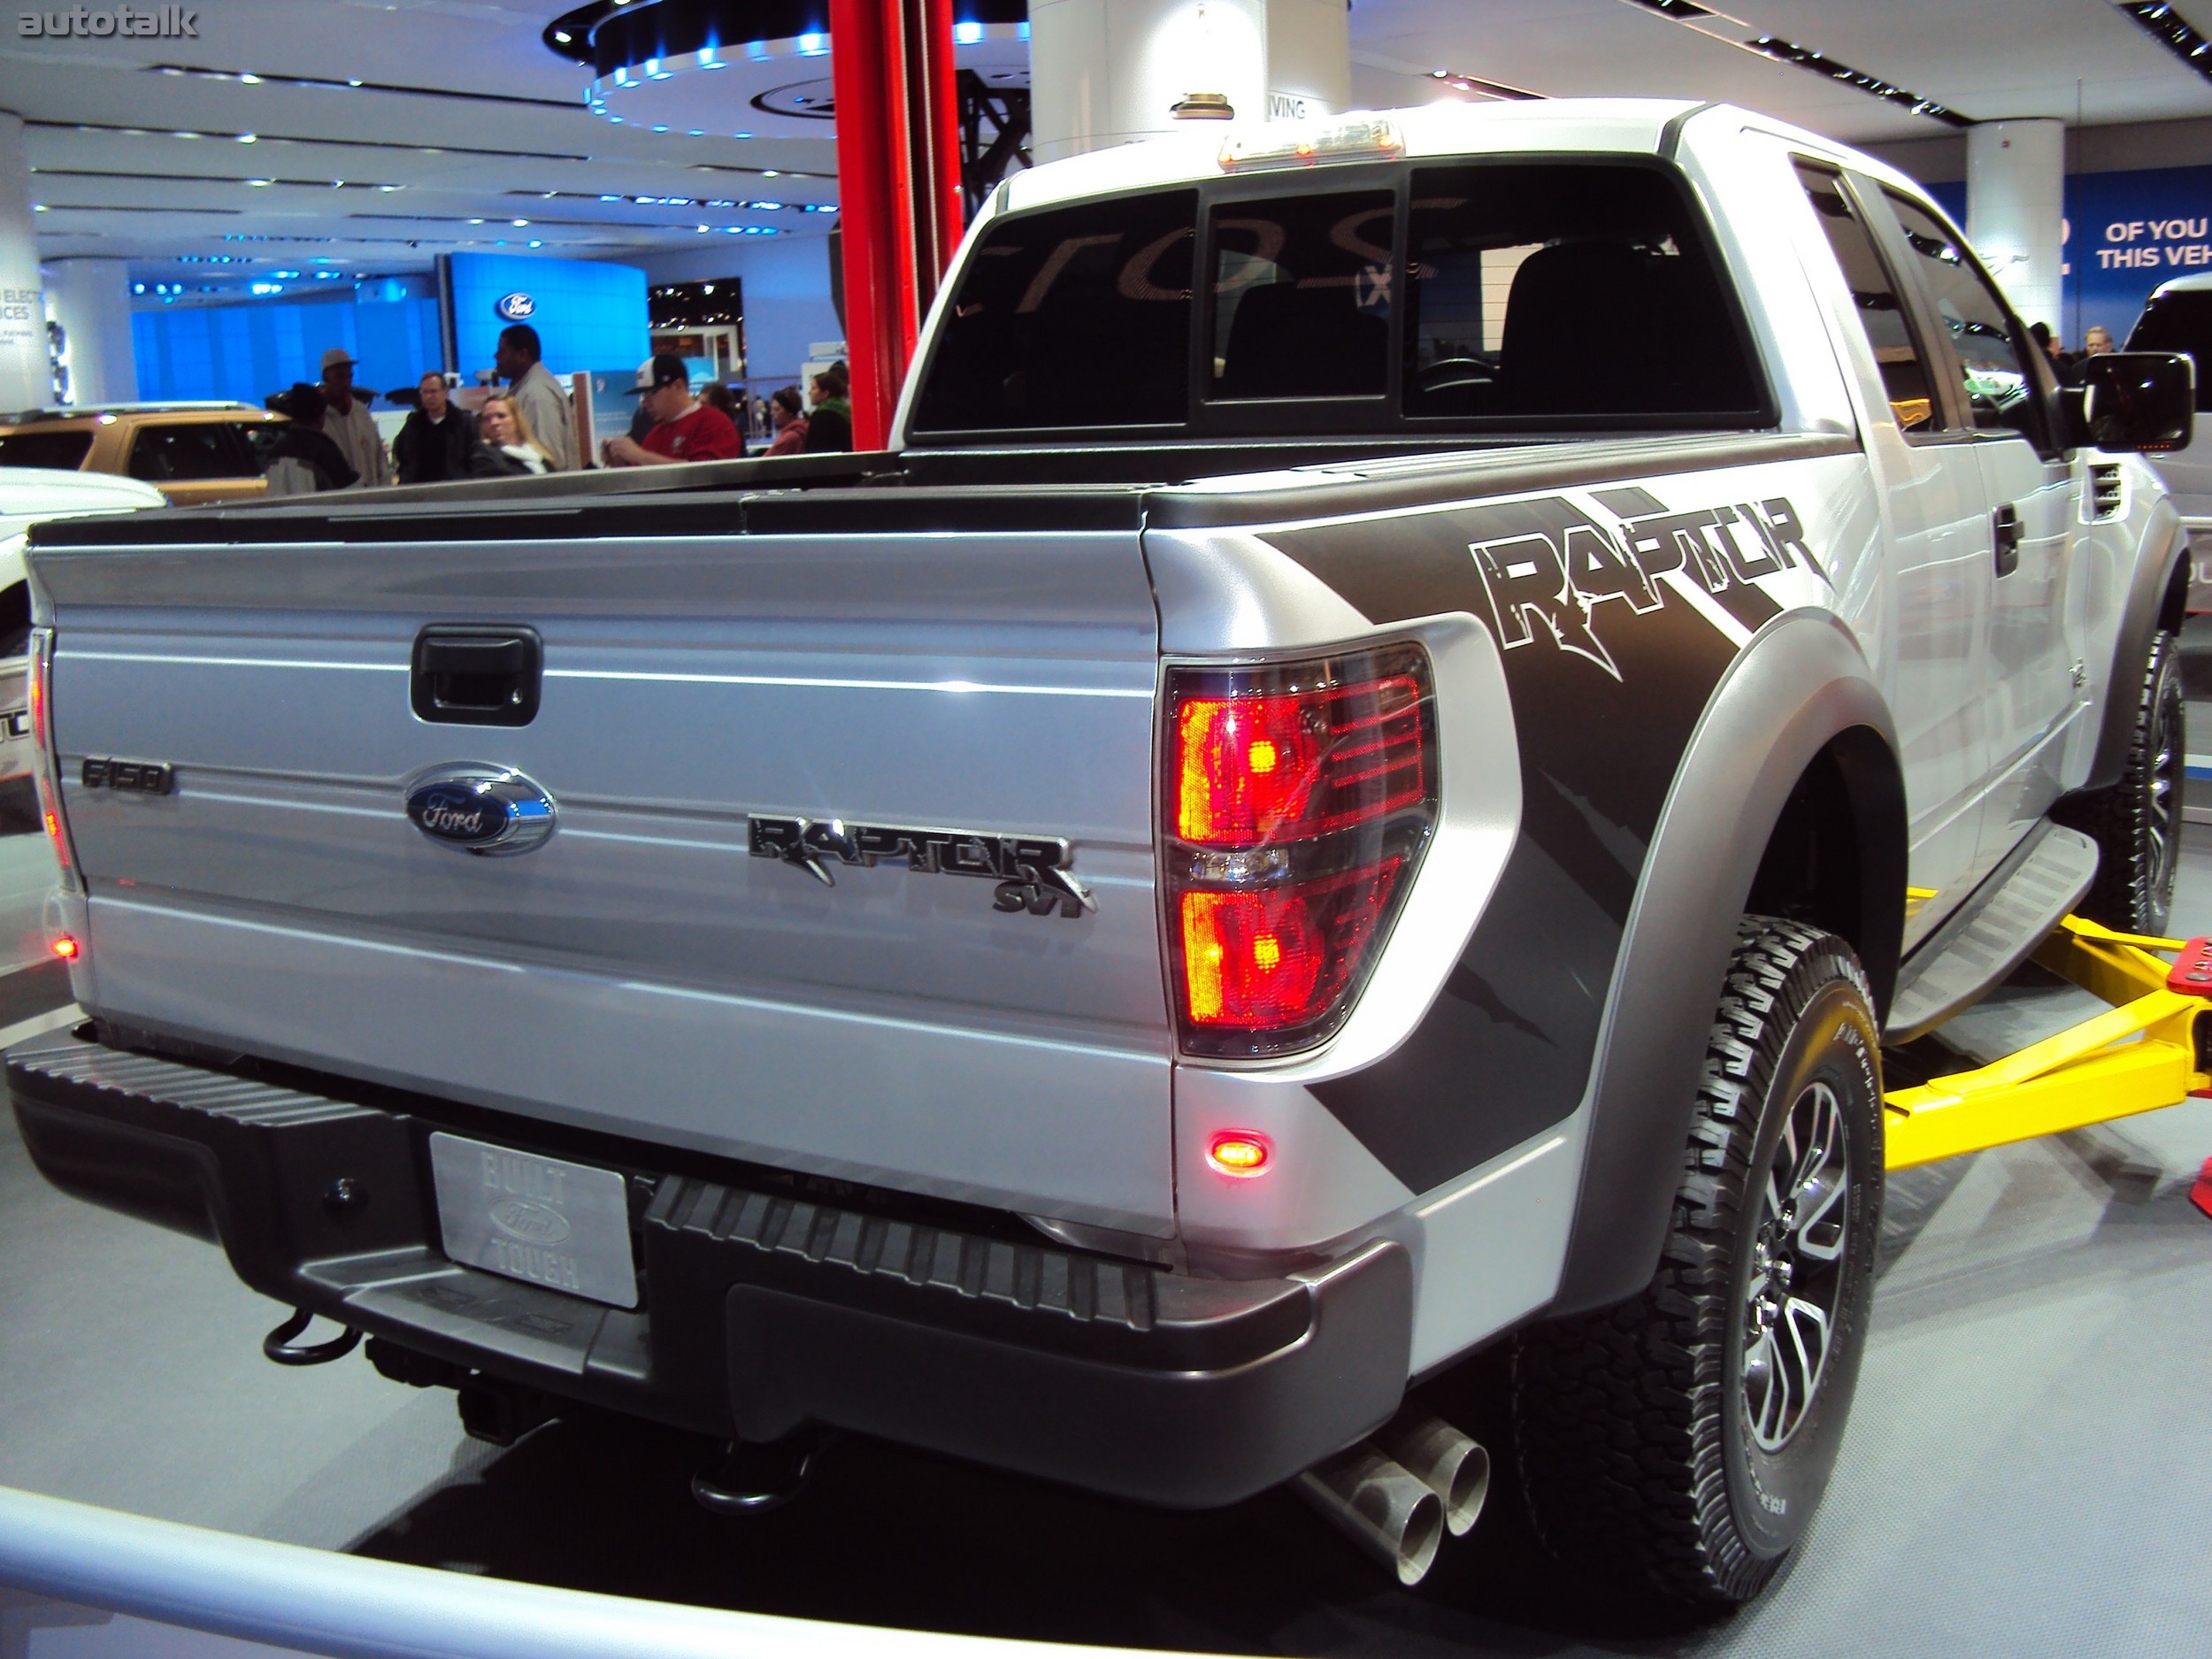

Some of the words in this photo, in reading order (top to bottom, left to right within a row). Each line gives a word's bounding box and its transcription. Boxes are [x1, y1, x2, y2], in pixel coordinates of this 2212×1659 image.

[2106, 223, 2144, 242] OF
[2147, 218, 2208, 240] YOU
[2096, 248, 2160, 269] THIS
[507, 295, 534, 316] Ford
[1469, 496, 1837, 682] RAPTOR
[421, 793, 483, 833] Ford
[748, 812, 1098, 913] RAPTOR
[993, 880, 1089, 918] SVT
[481, 1151, 567, 1205] BUILT
[504, 1202, 556, 1237] Ford
[490, 1238, 580, 1289] TOUGH
